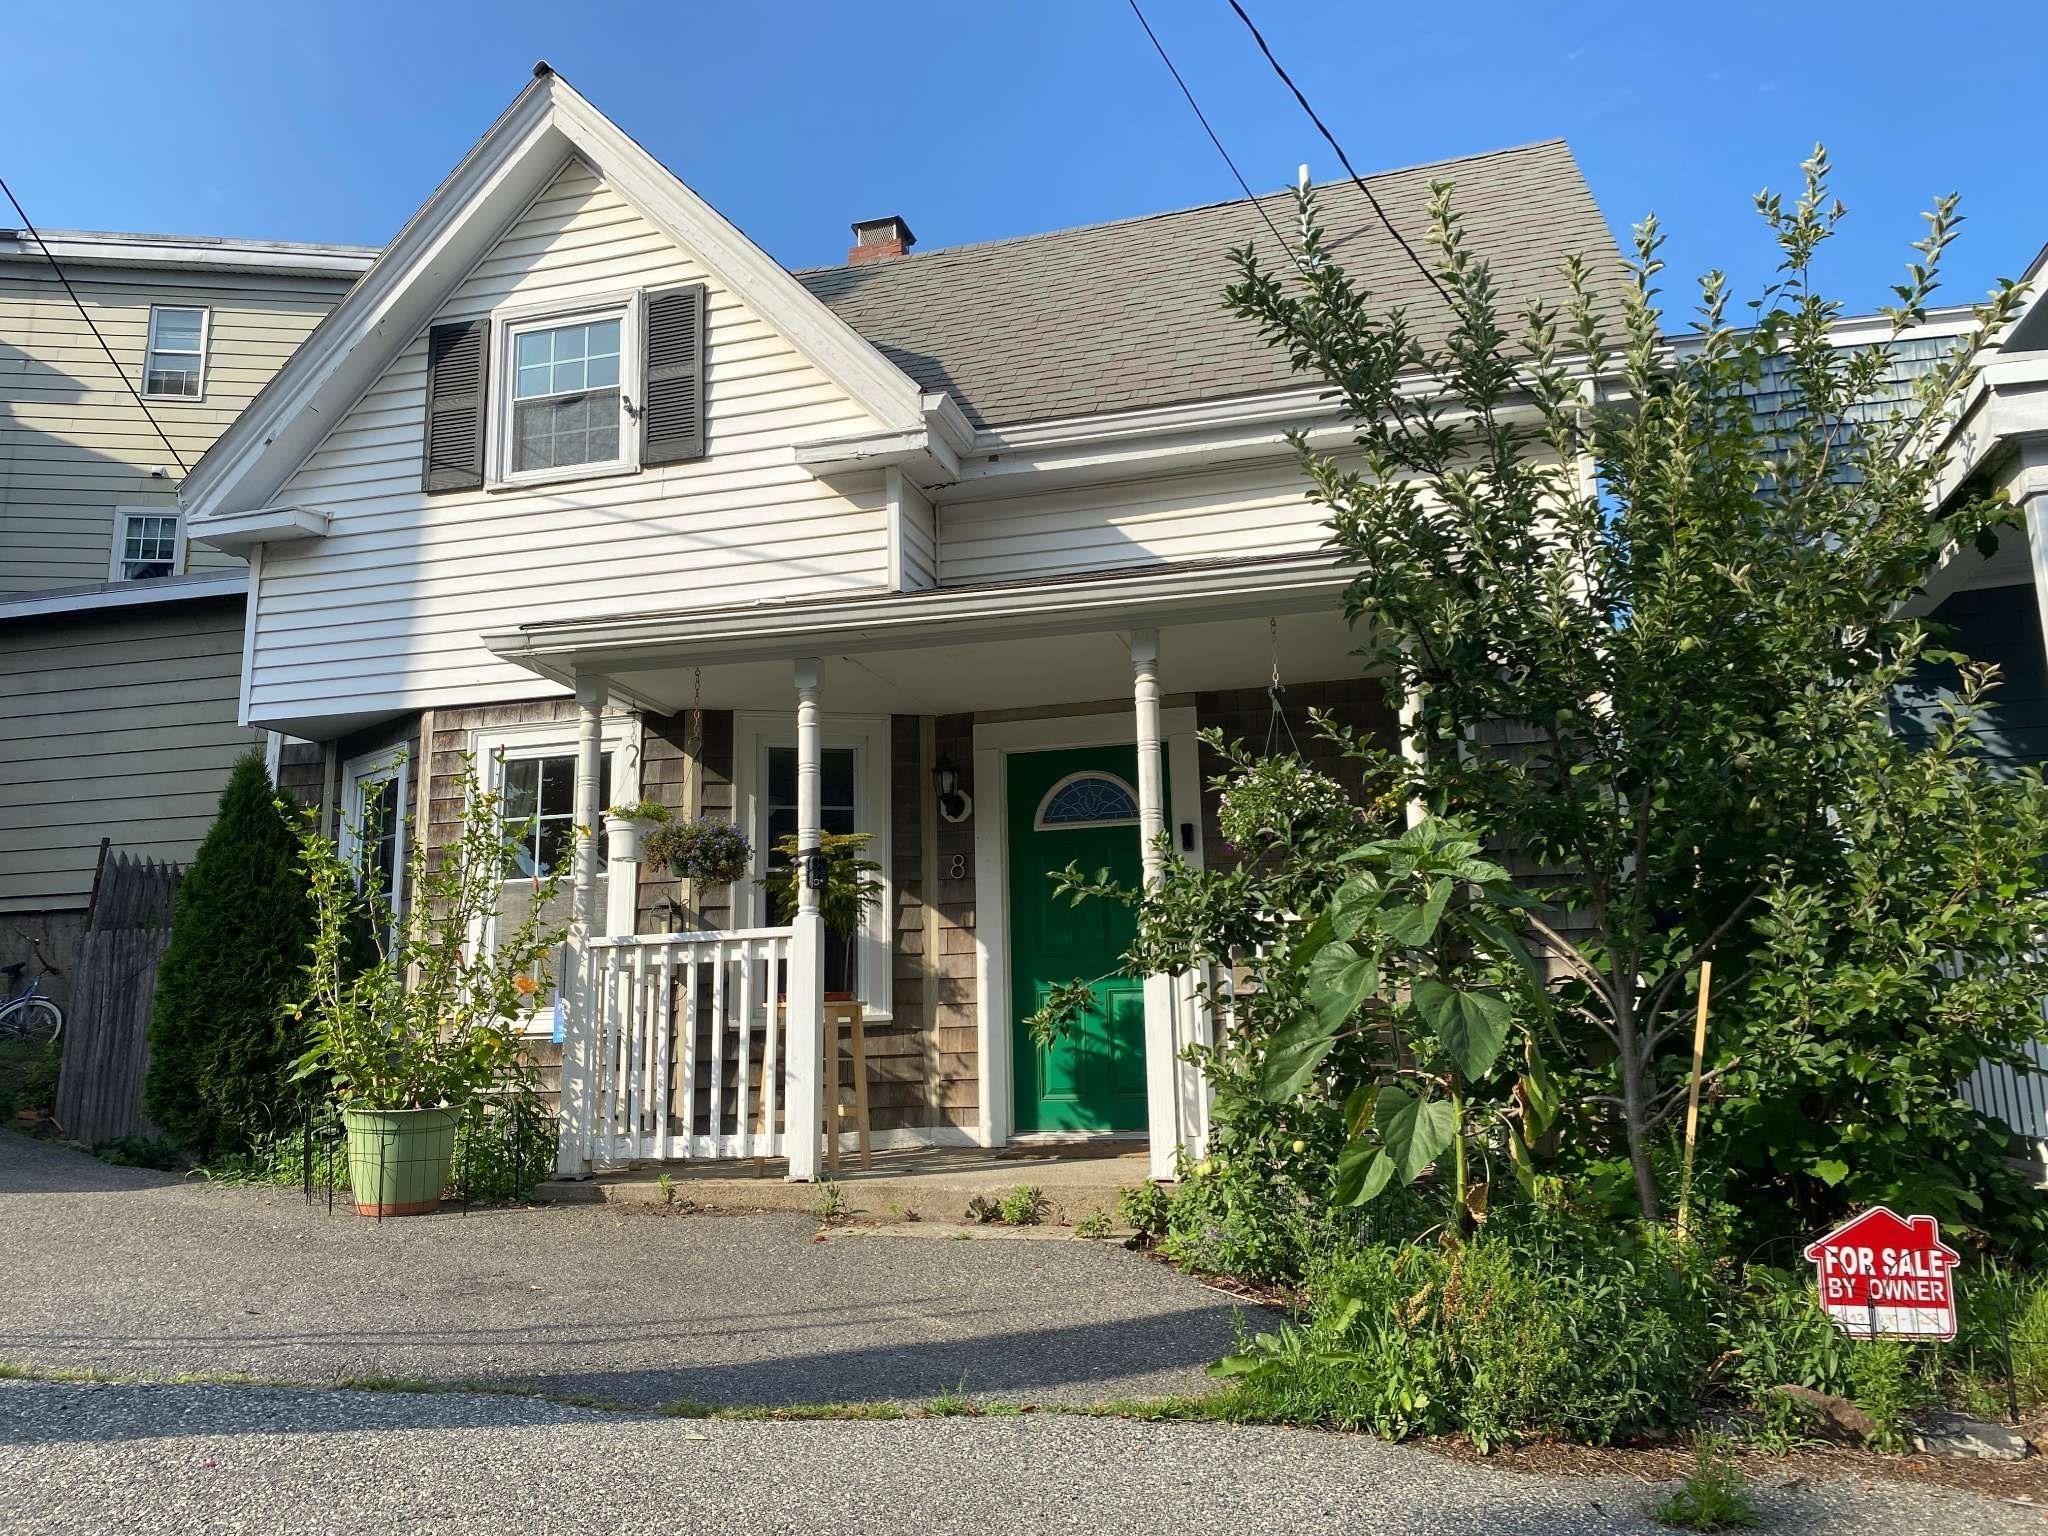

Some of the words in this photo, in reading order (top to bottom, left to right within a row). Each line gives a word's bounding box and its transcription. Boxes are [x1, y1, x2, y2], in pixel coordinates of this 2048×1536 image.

[951, 854, 964, 878] 8
[1824, 1246, 1876, 1276] FOR
[1882, 1247, 1945, 1278] SALE
[1828, 1277, 1856, 1299] BY
[1869, 1279, 1946, 1302] OWNER
